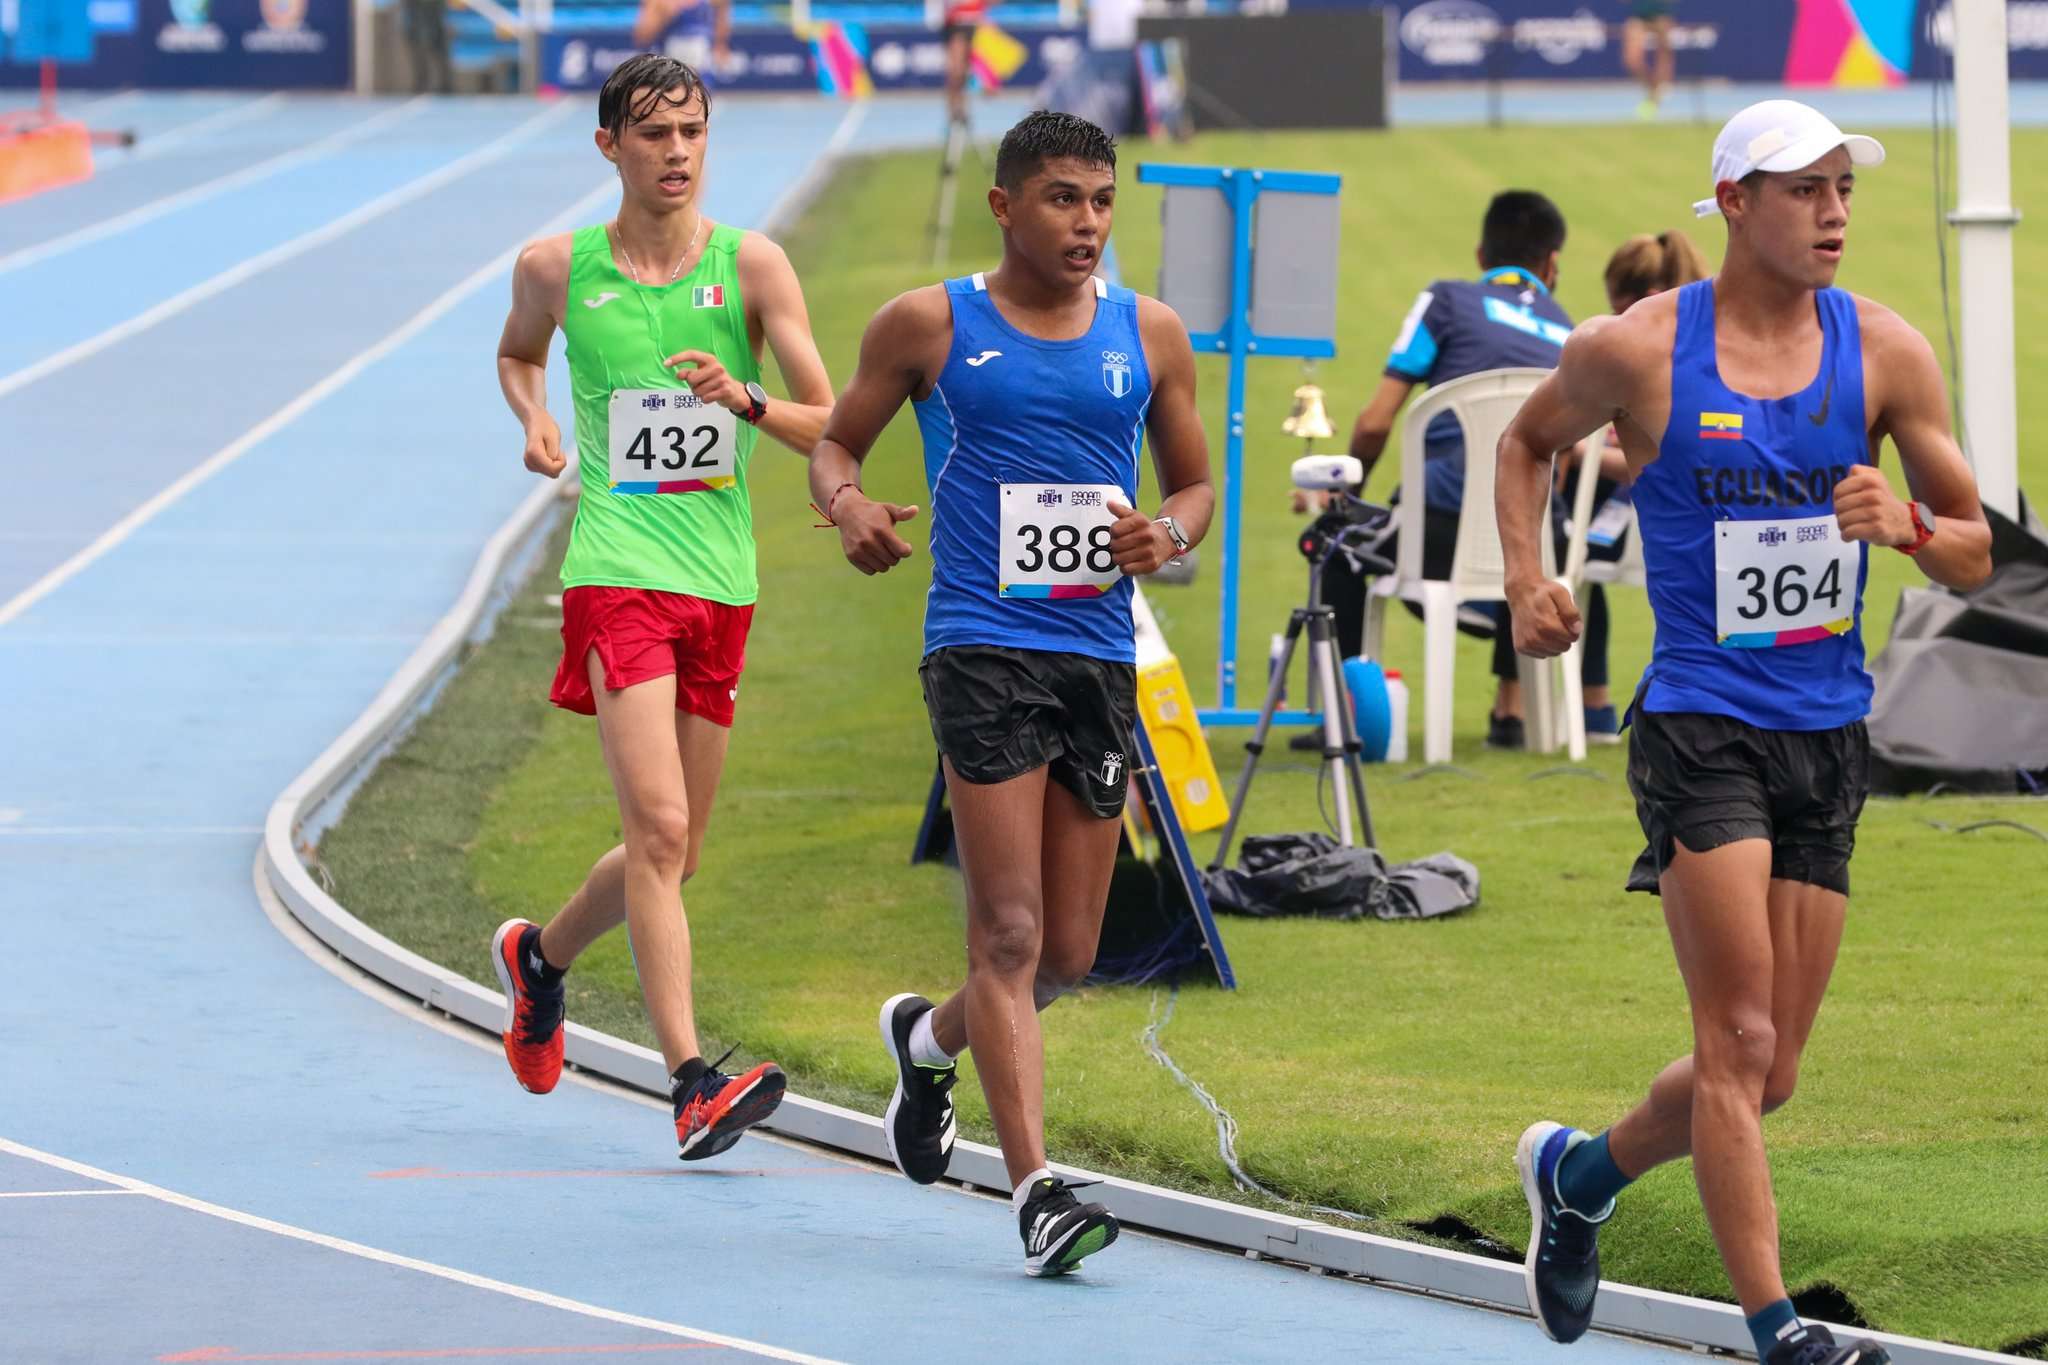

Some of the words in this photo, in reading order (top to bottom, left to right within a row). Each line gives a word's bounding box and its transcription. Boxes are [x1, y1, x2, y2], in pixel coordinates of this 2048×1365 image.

[626, 425, 719, 470] 432
[1072, 491, 1101, 499] PANAM
[1016, 524, 1119, 573] 388
[1736, 558, 1842, 620] 364
